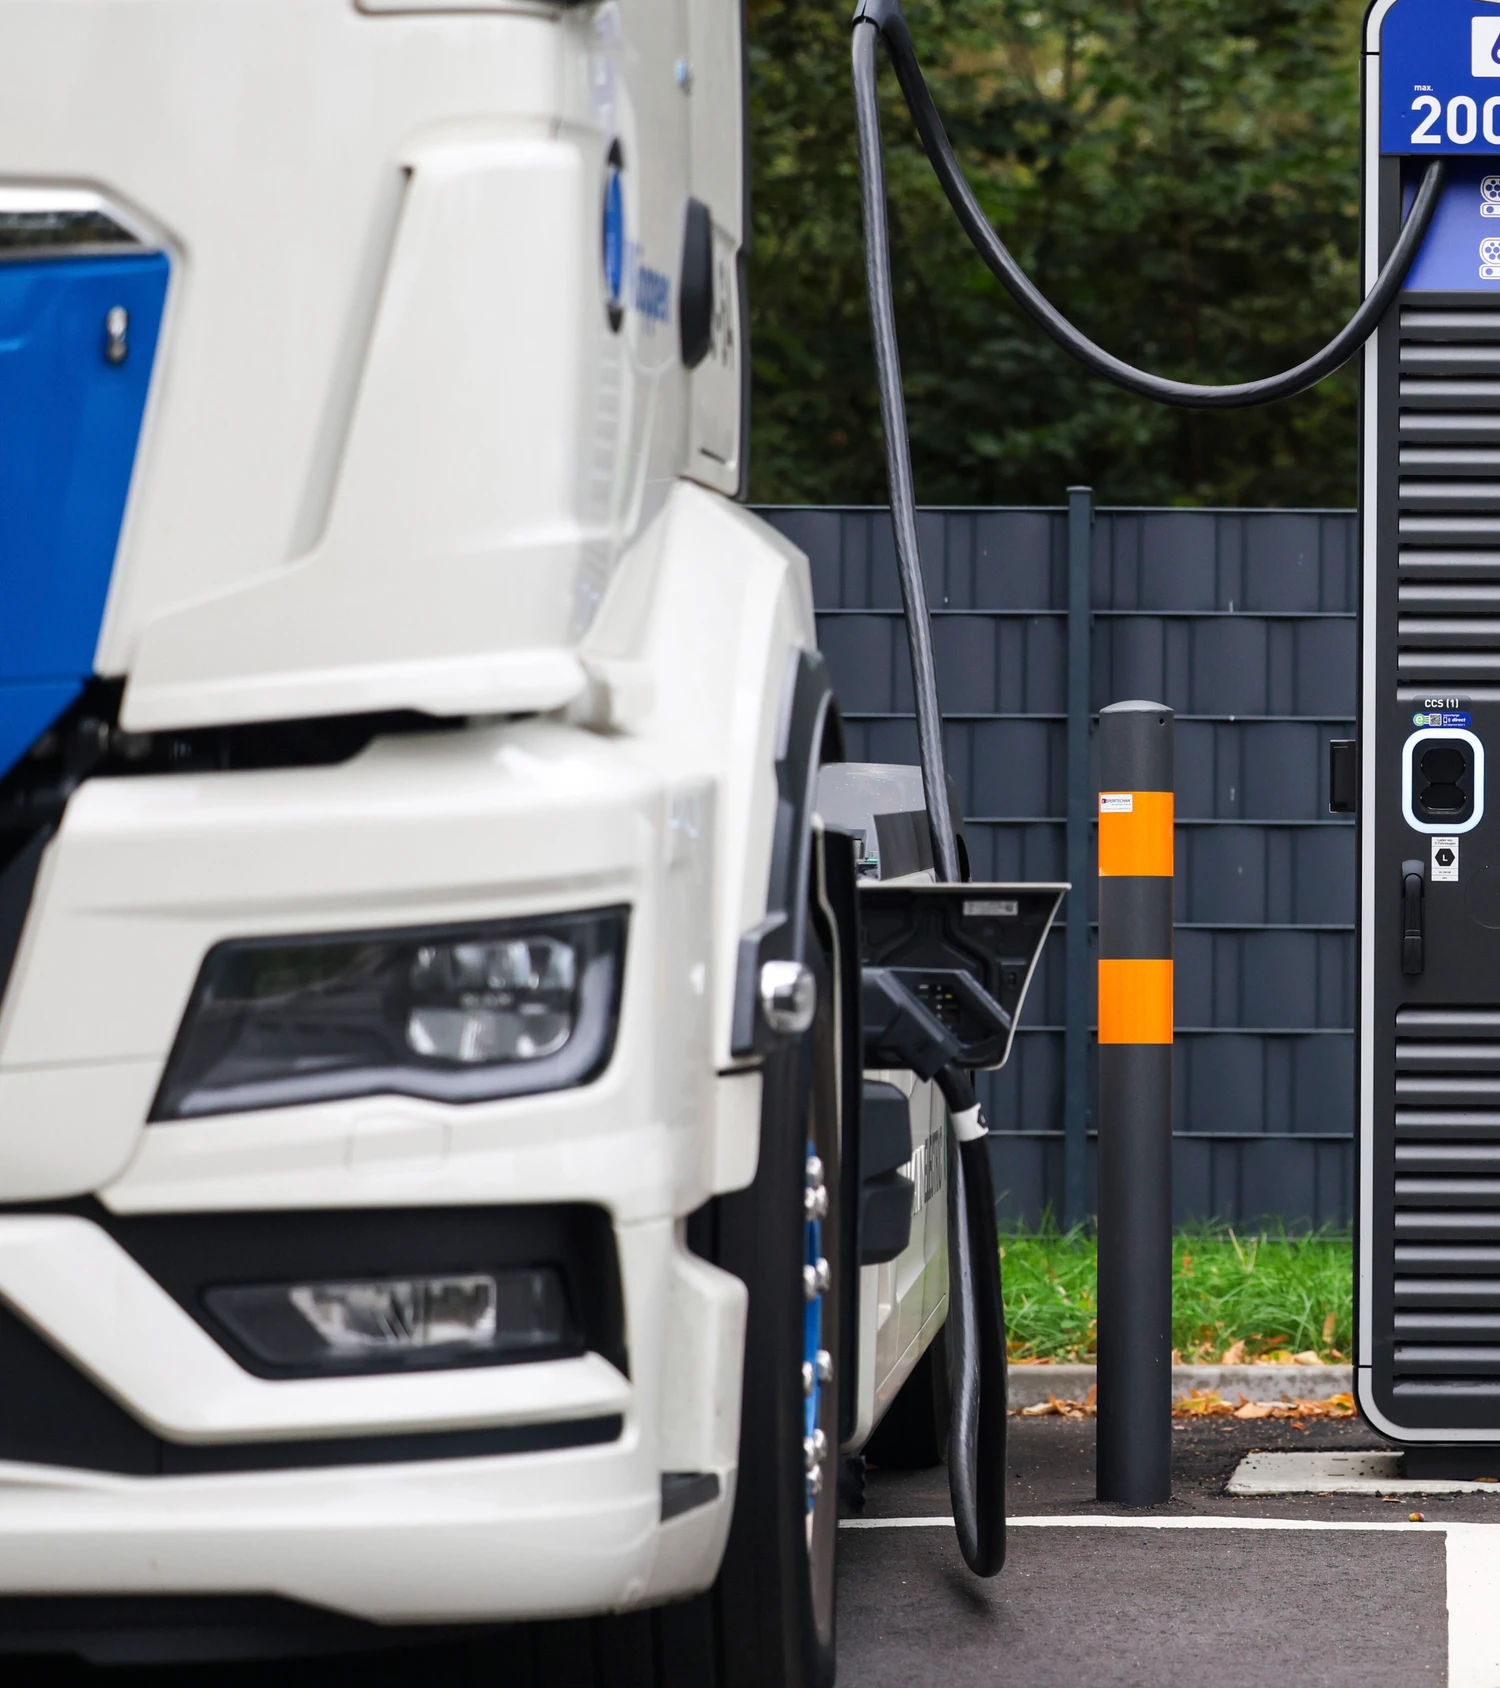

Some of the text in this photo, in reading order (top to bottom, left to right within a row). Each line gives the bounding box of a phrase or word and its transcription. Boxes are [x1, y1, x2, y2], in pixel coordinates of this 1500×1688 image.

[1413, 84, 1434, 92] max.
[1424, 699, 1444, 708] CCS
[1442, 854, 1449, 862] L
